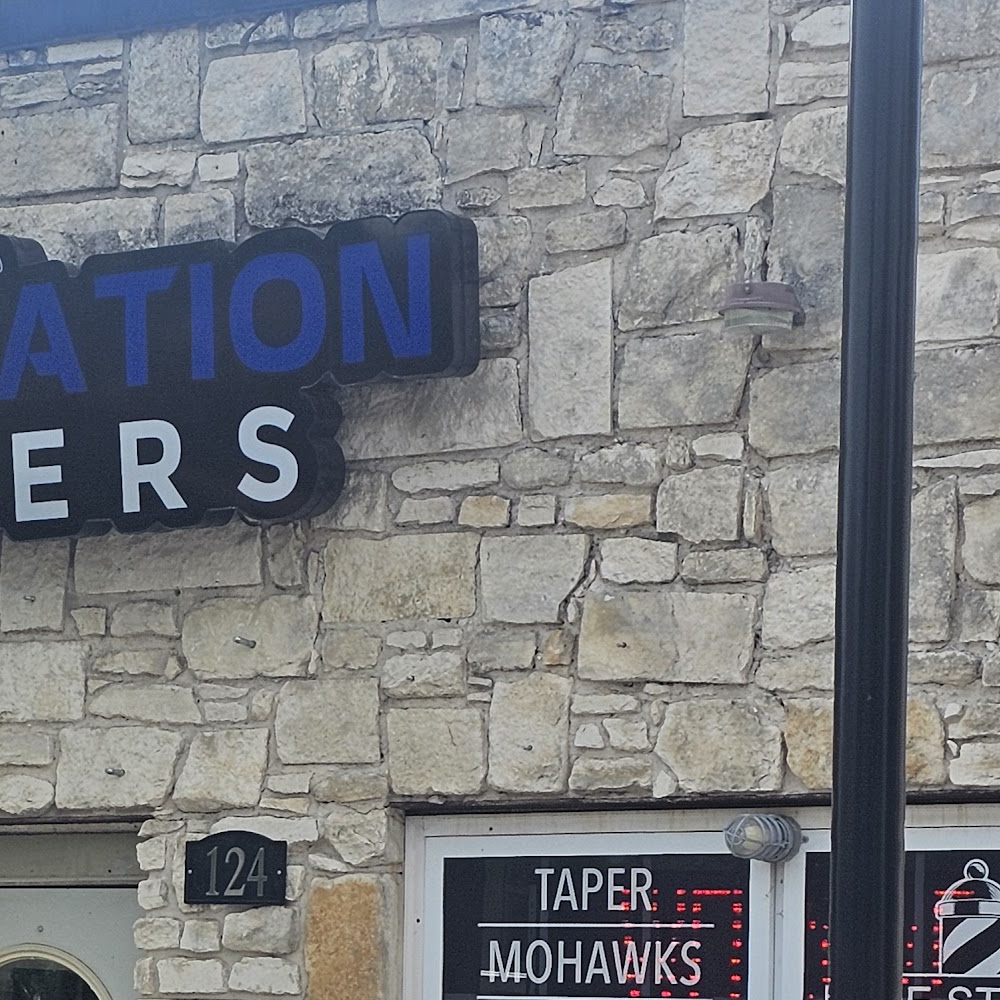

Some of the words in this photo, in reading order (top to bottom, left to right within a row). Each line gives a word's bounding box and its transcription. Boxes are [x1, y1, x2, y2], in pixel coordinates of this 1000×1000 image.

[205, 845, 268, 897] 124
[534, 867, 653, 911] TAPER
[488, 939, 702, 986] MOHAWKS
